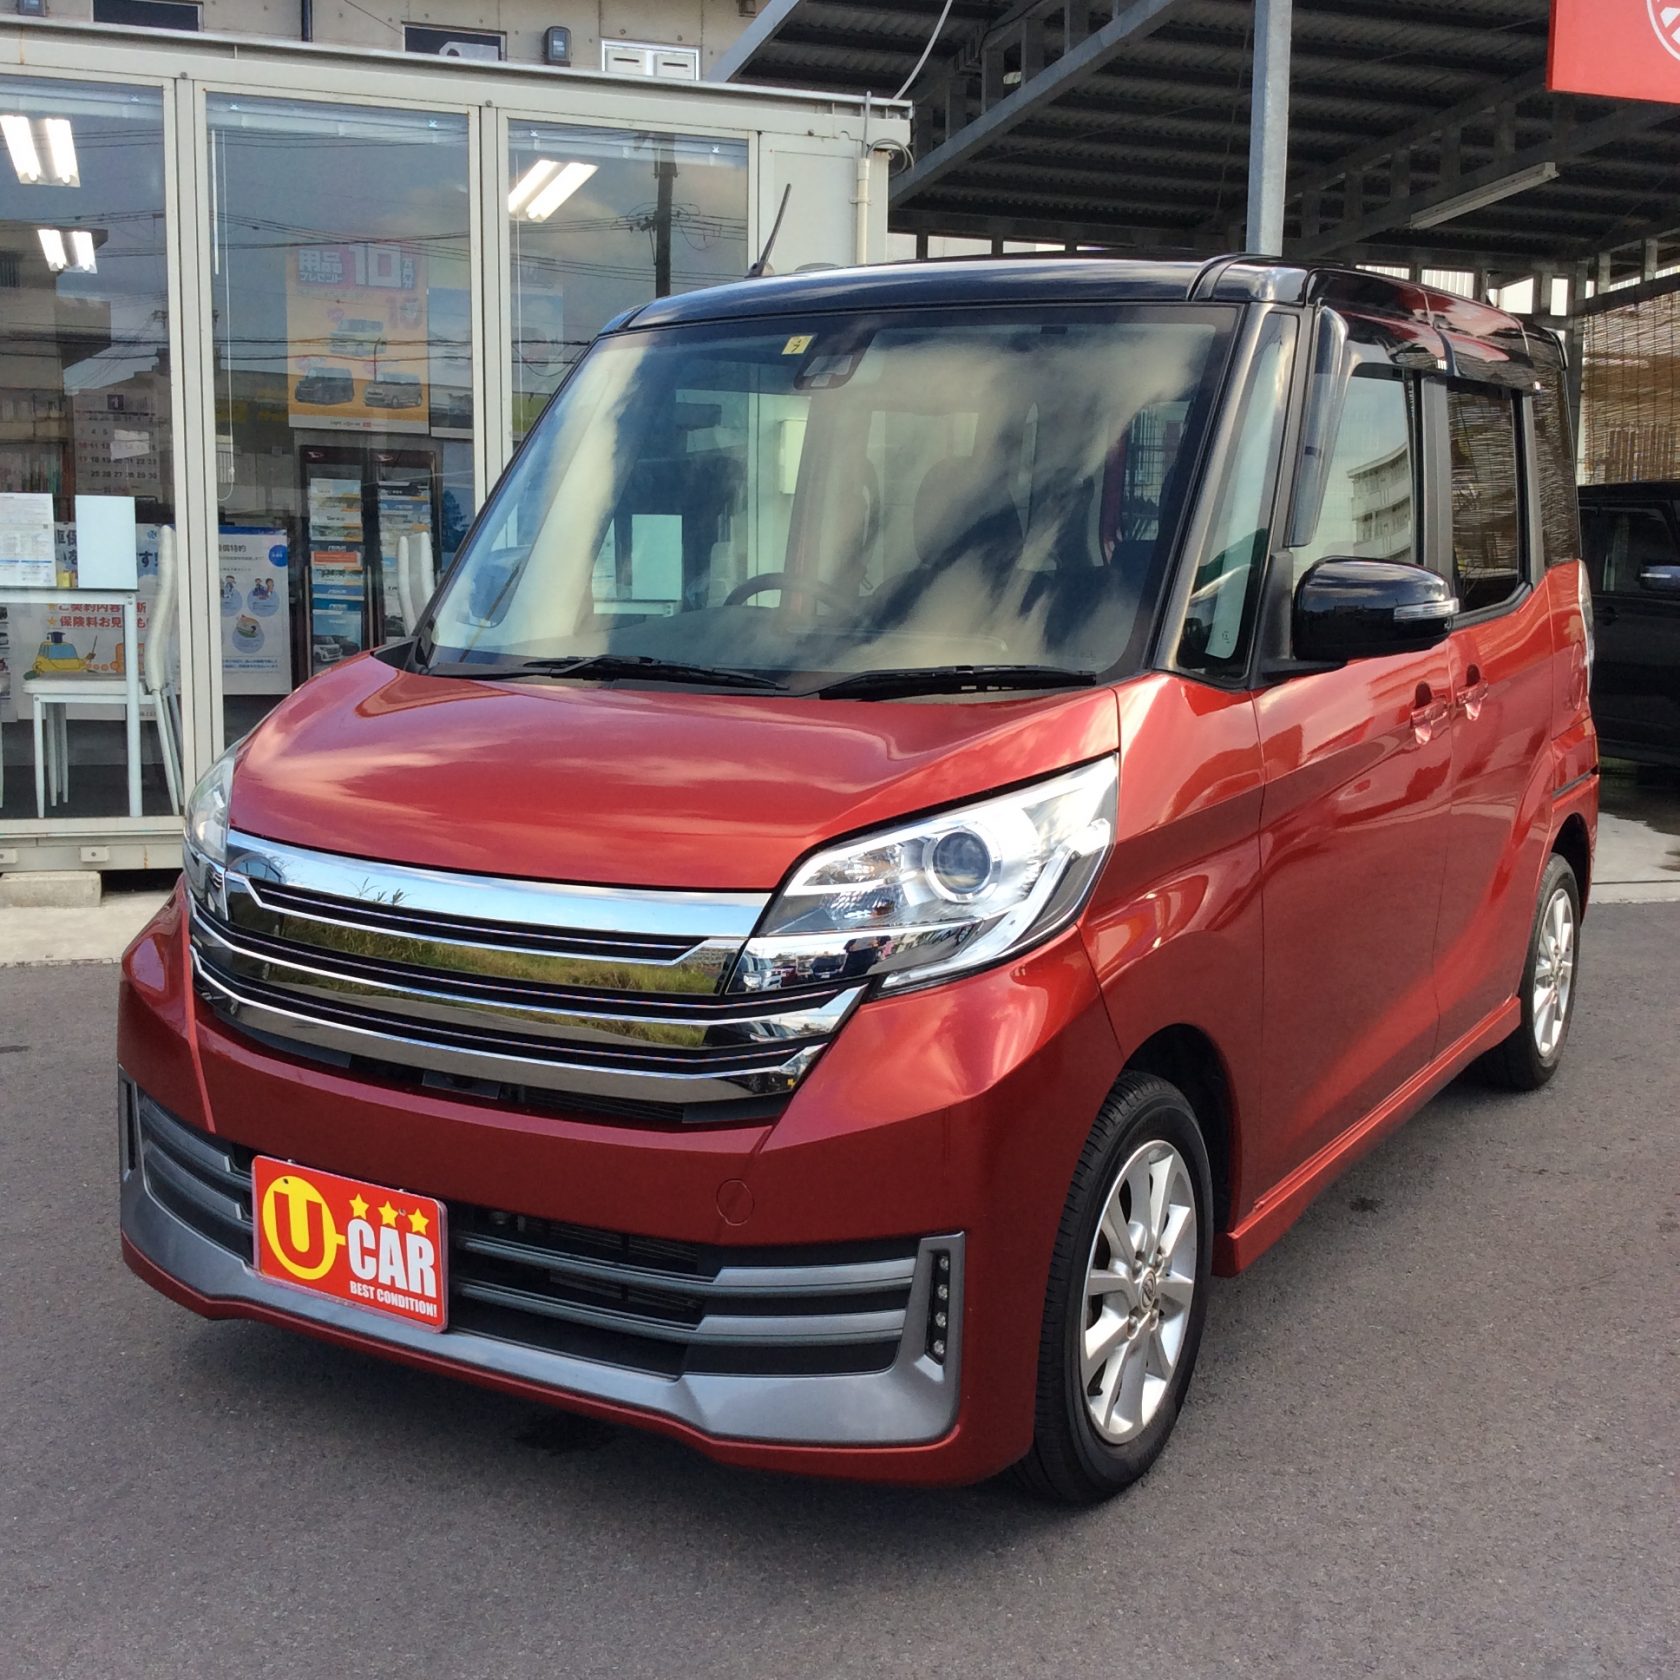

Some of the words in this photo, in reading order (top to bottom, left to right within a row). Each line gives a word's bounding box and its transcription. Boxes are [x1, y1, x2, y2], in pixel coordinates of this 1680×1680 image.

[349, 243, 401, 288] 10
[350, 1281, 375, 1300] BEST
[377, 1288, 437, 1318] CONDITION!
